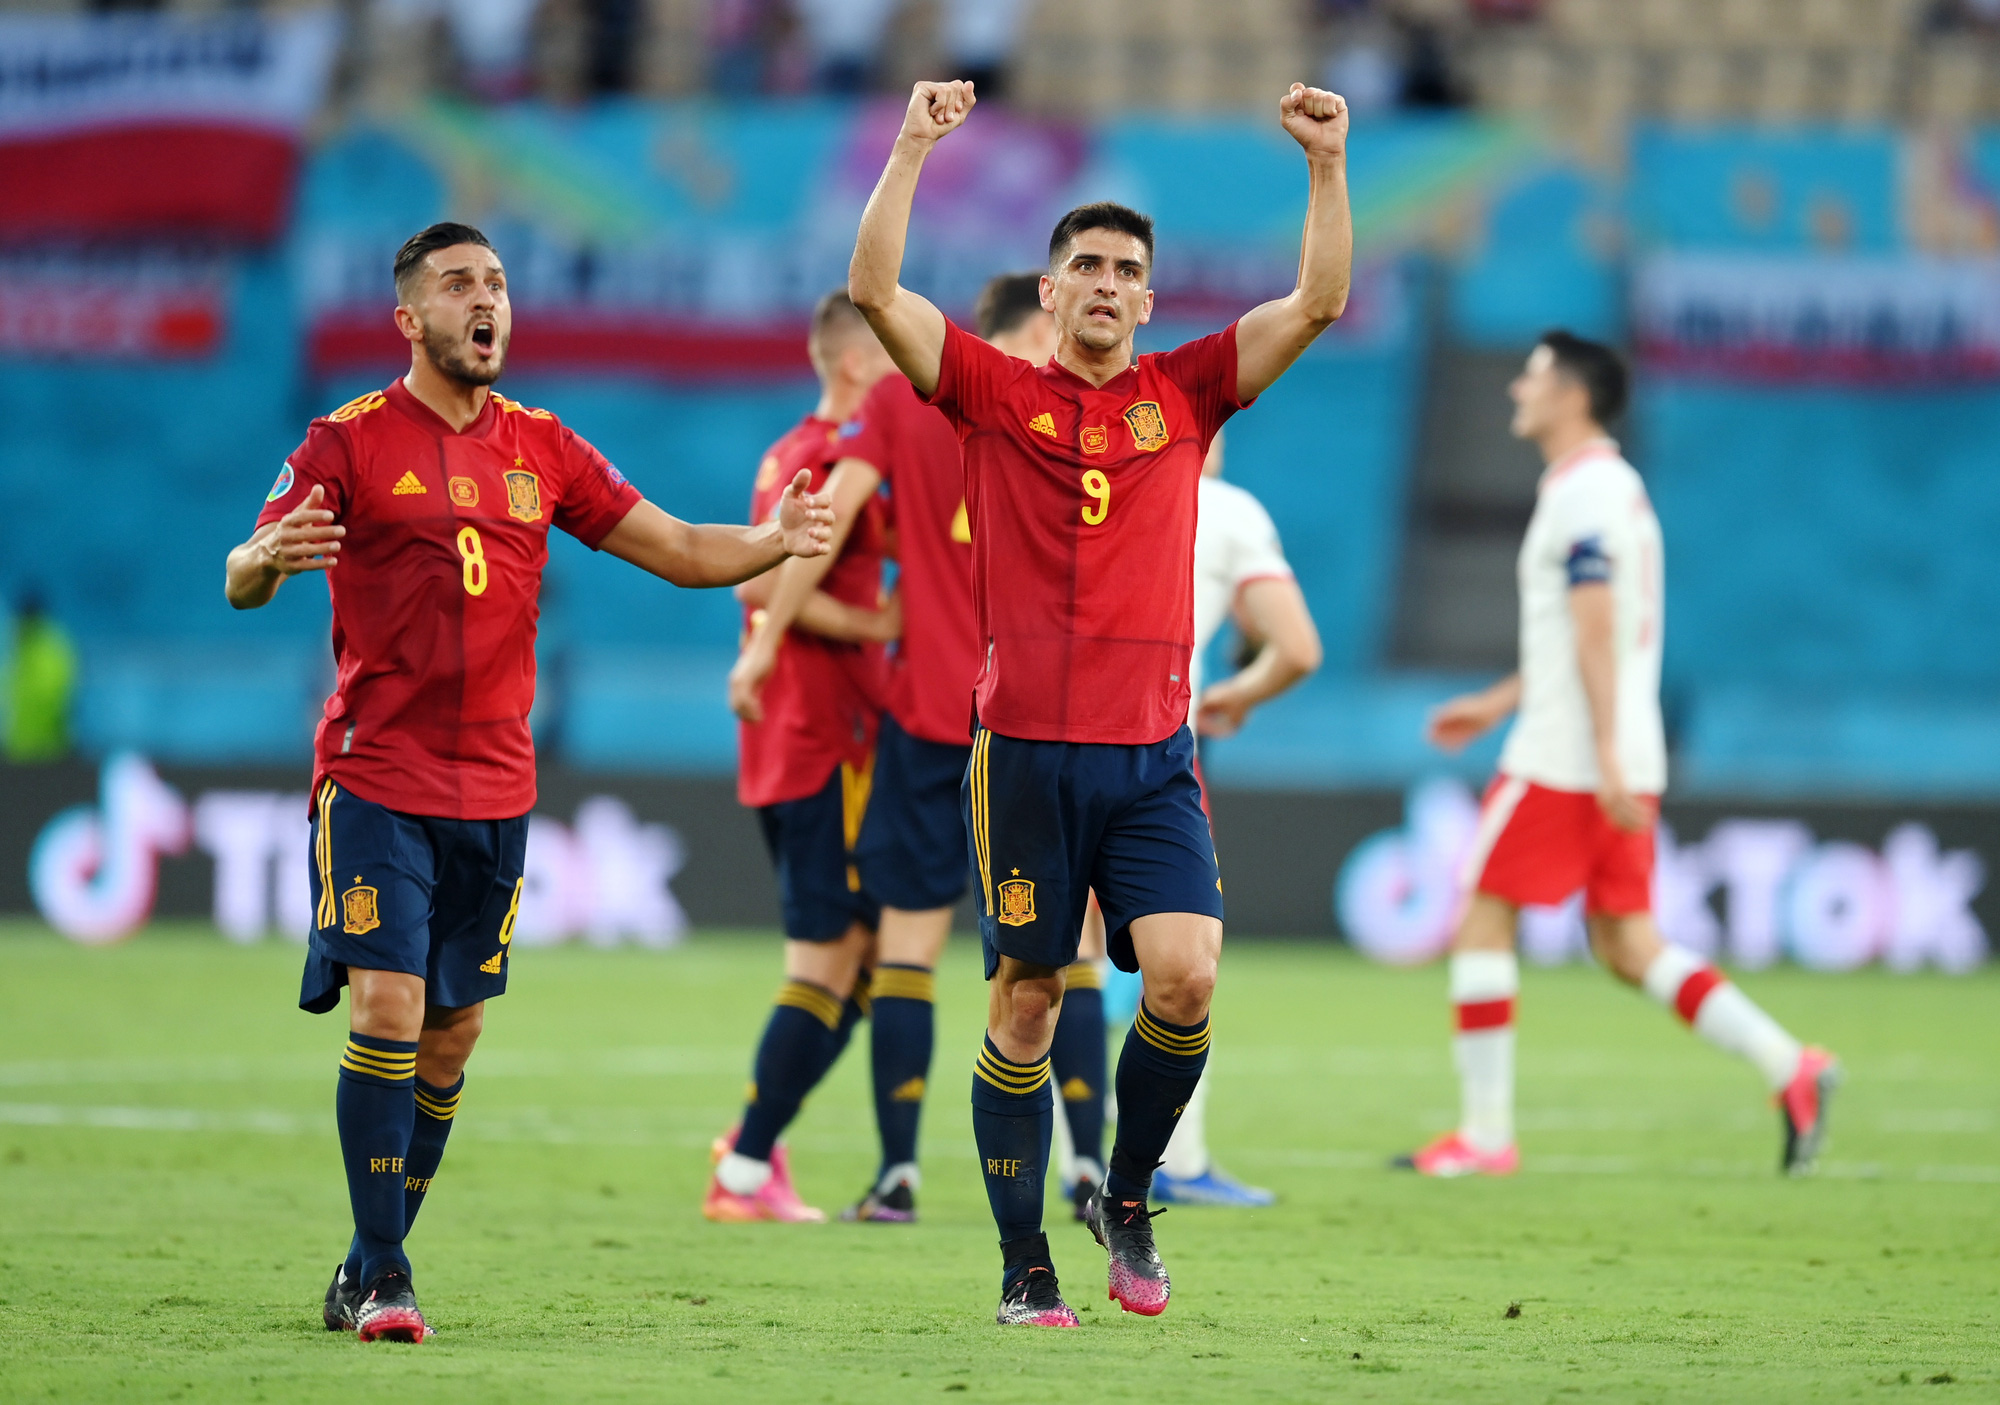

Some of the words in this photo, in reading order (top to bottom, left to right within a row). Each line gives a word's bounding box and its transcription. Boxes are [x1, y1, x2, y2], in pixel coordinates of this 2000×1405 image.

[1029, 421, 1057, 438] adidas
[392, 485, 427, 496] adidas
[1081, 469, 1110, 525] 9
[457, 526, 488, 596] 8
[499, 876, 523, 945] 8
[370, 1157, 404, 1173] RFEF
[987, 1158, 1021, 1177] RFEF
